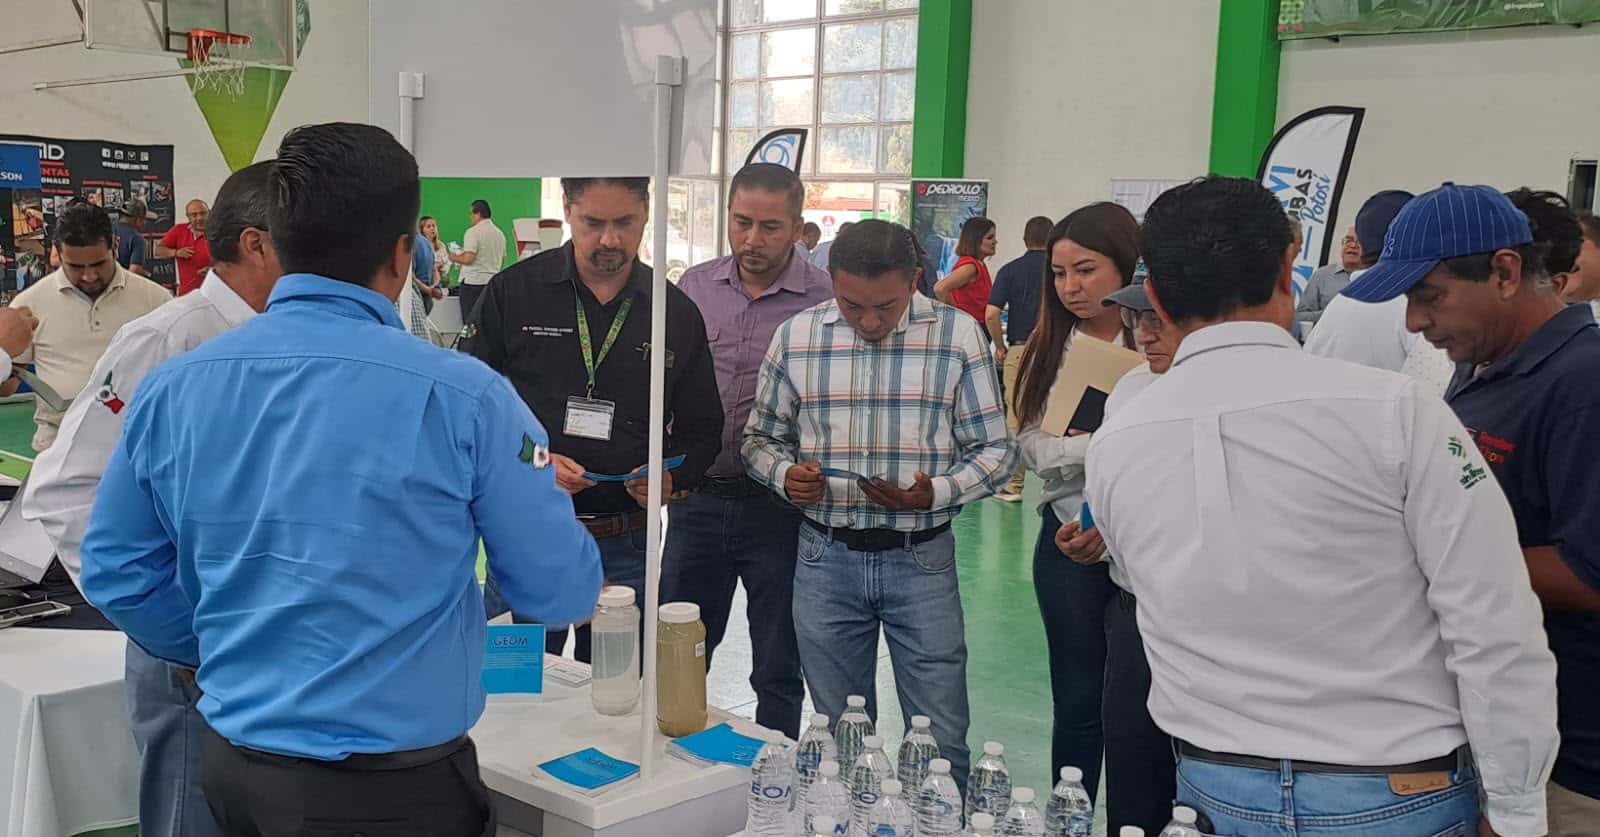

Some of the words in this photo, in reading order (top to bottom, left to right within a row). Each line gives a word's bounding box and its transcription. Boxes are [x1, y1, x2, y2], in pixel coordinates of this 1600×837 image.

[39, 143, 65, 160] ID
[0, 171, 23, 181] SON
[926, 184, 981, 196] PEDROLLO
[1268, 165, 1297, 208] VI
